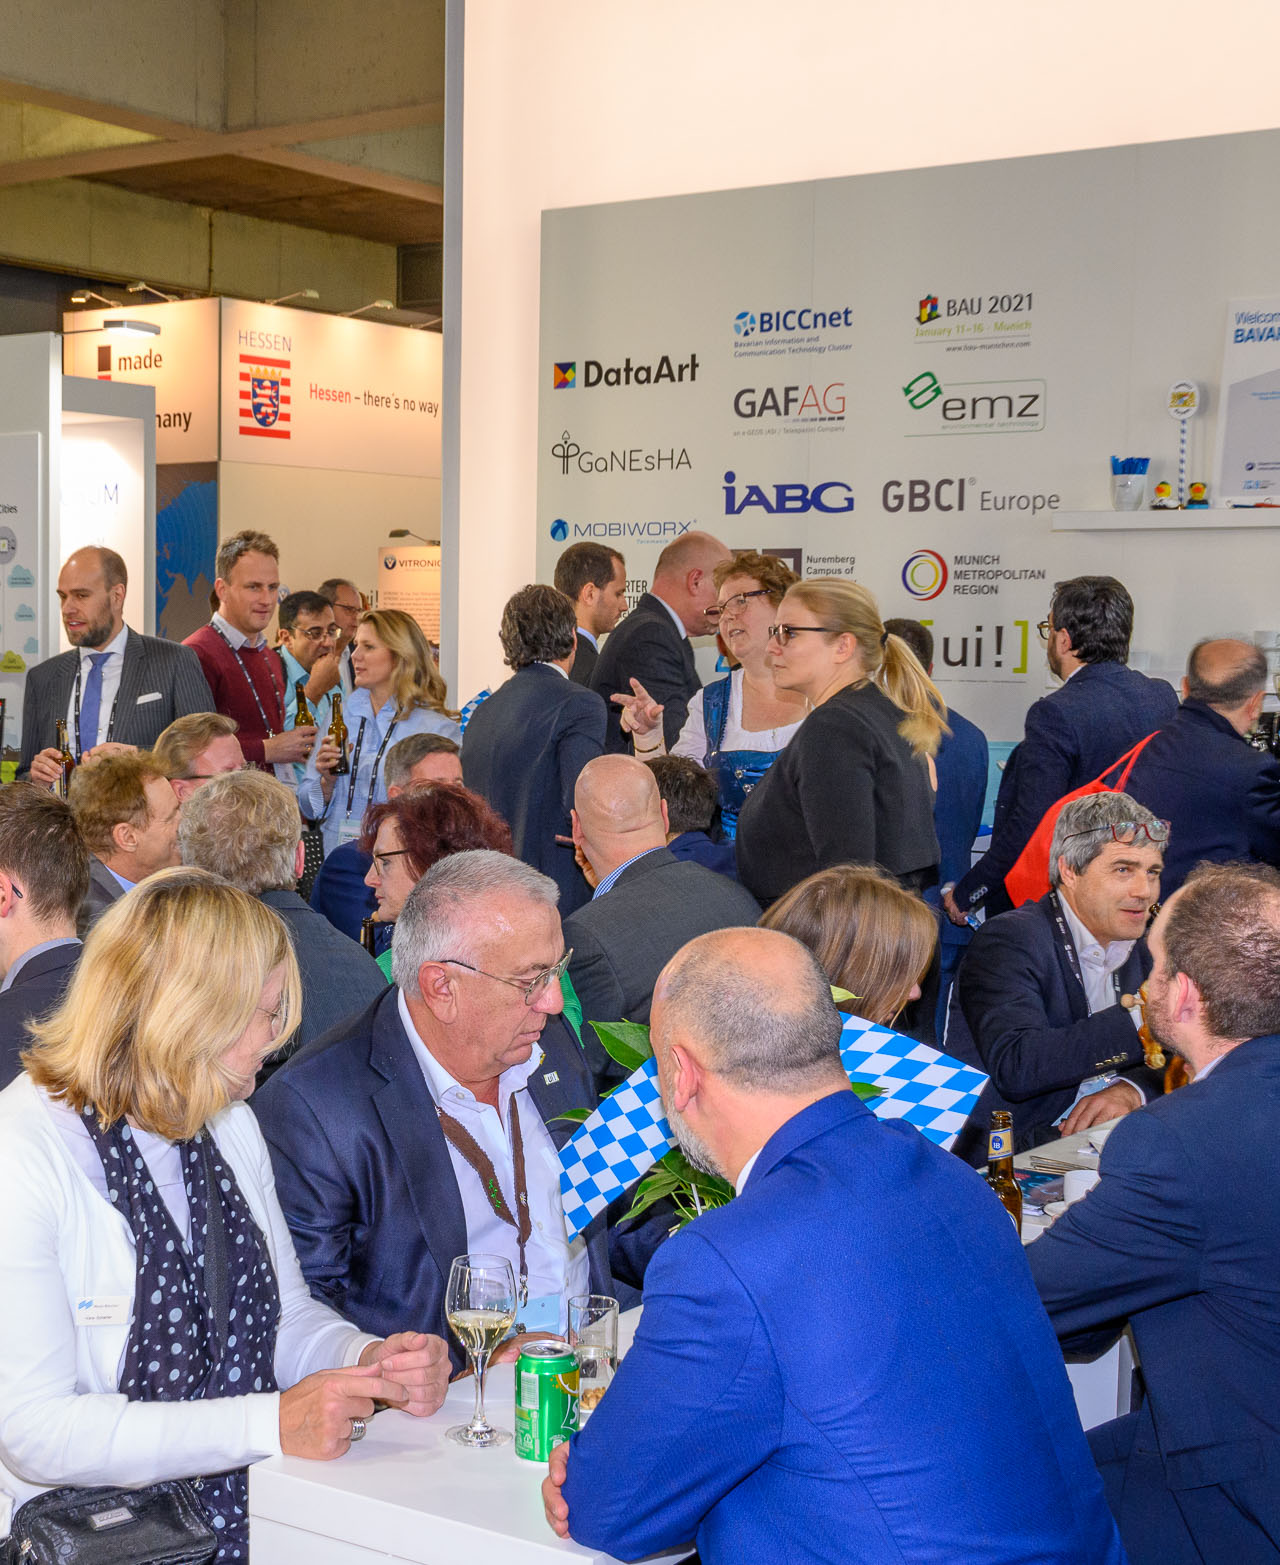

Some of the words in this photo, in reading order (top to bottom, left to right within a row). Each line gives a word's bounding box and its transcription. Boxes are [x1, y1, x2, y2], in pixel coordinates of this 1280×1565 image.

[946, 297, 982, 317] BAU
[988, 292, 1033, 314] 2021
[759, 307, 853, 333] BICCnet
[237, 329, 292, 353] HESSEN
[118, 349, 163, 372] made
[734, 348, 786, 358] Communication
[583, 353, 699, 388] DataArt
[309, 383, 352, 404] Hessen
[403, 400, 416, 412] no
[418, 401, 440, 418] way
[942, 394, 1039, 421] emz
[577, 447, 692, 473] GaNEsHA
[980, 491, 1060, 515] Europe
[574, 521, 691, 537] MOBIWORX
[806, 555, 856, 565] Nuremberg
[806, 566, 842, 576] Campus
[844, 566, 854, 575] of
[953, 555, 1000, 566] MUNICH
[953, 569, 1046, 580] METROPOLITAN
[953, 584, 999, 595] REGION
